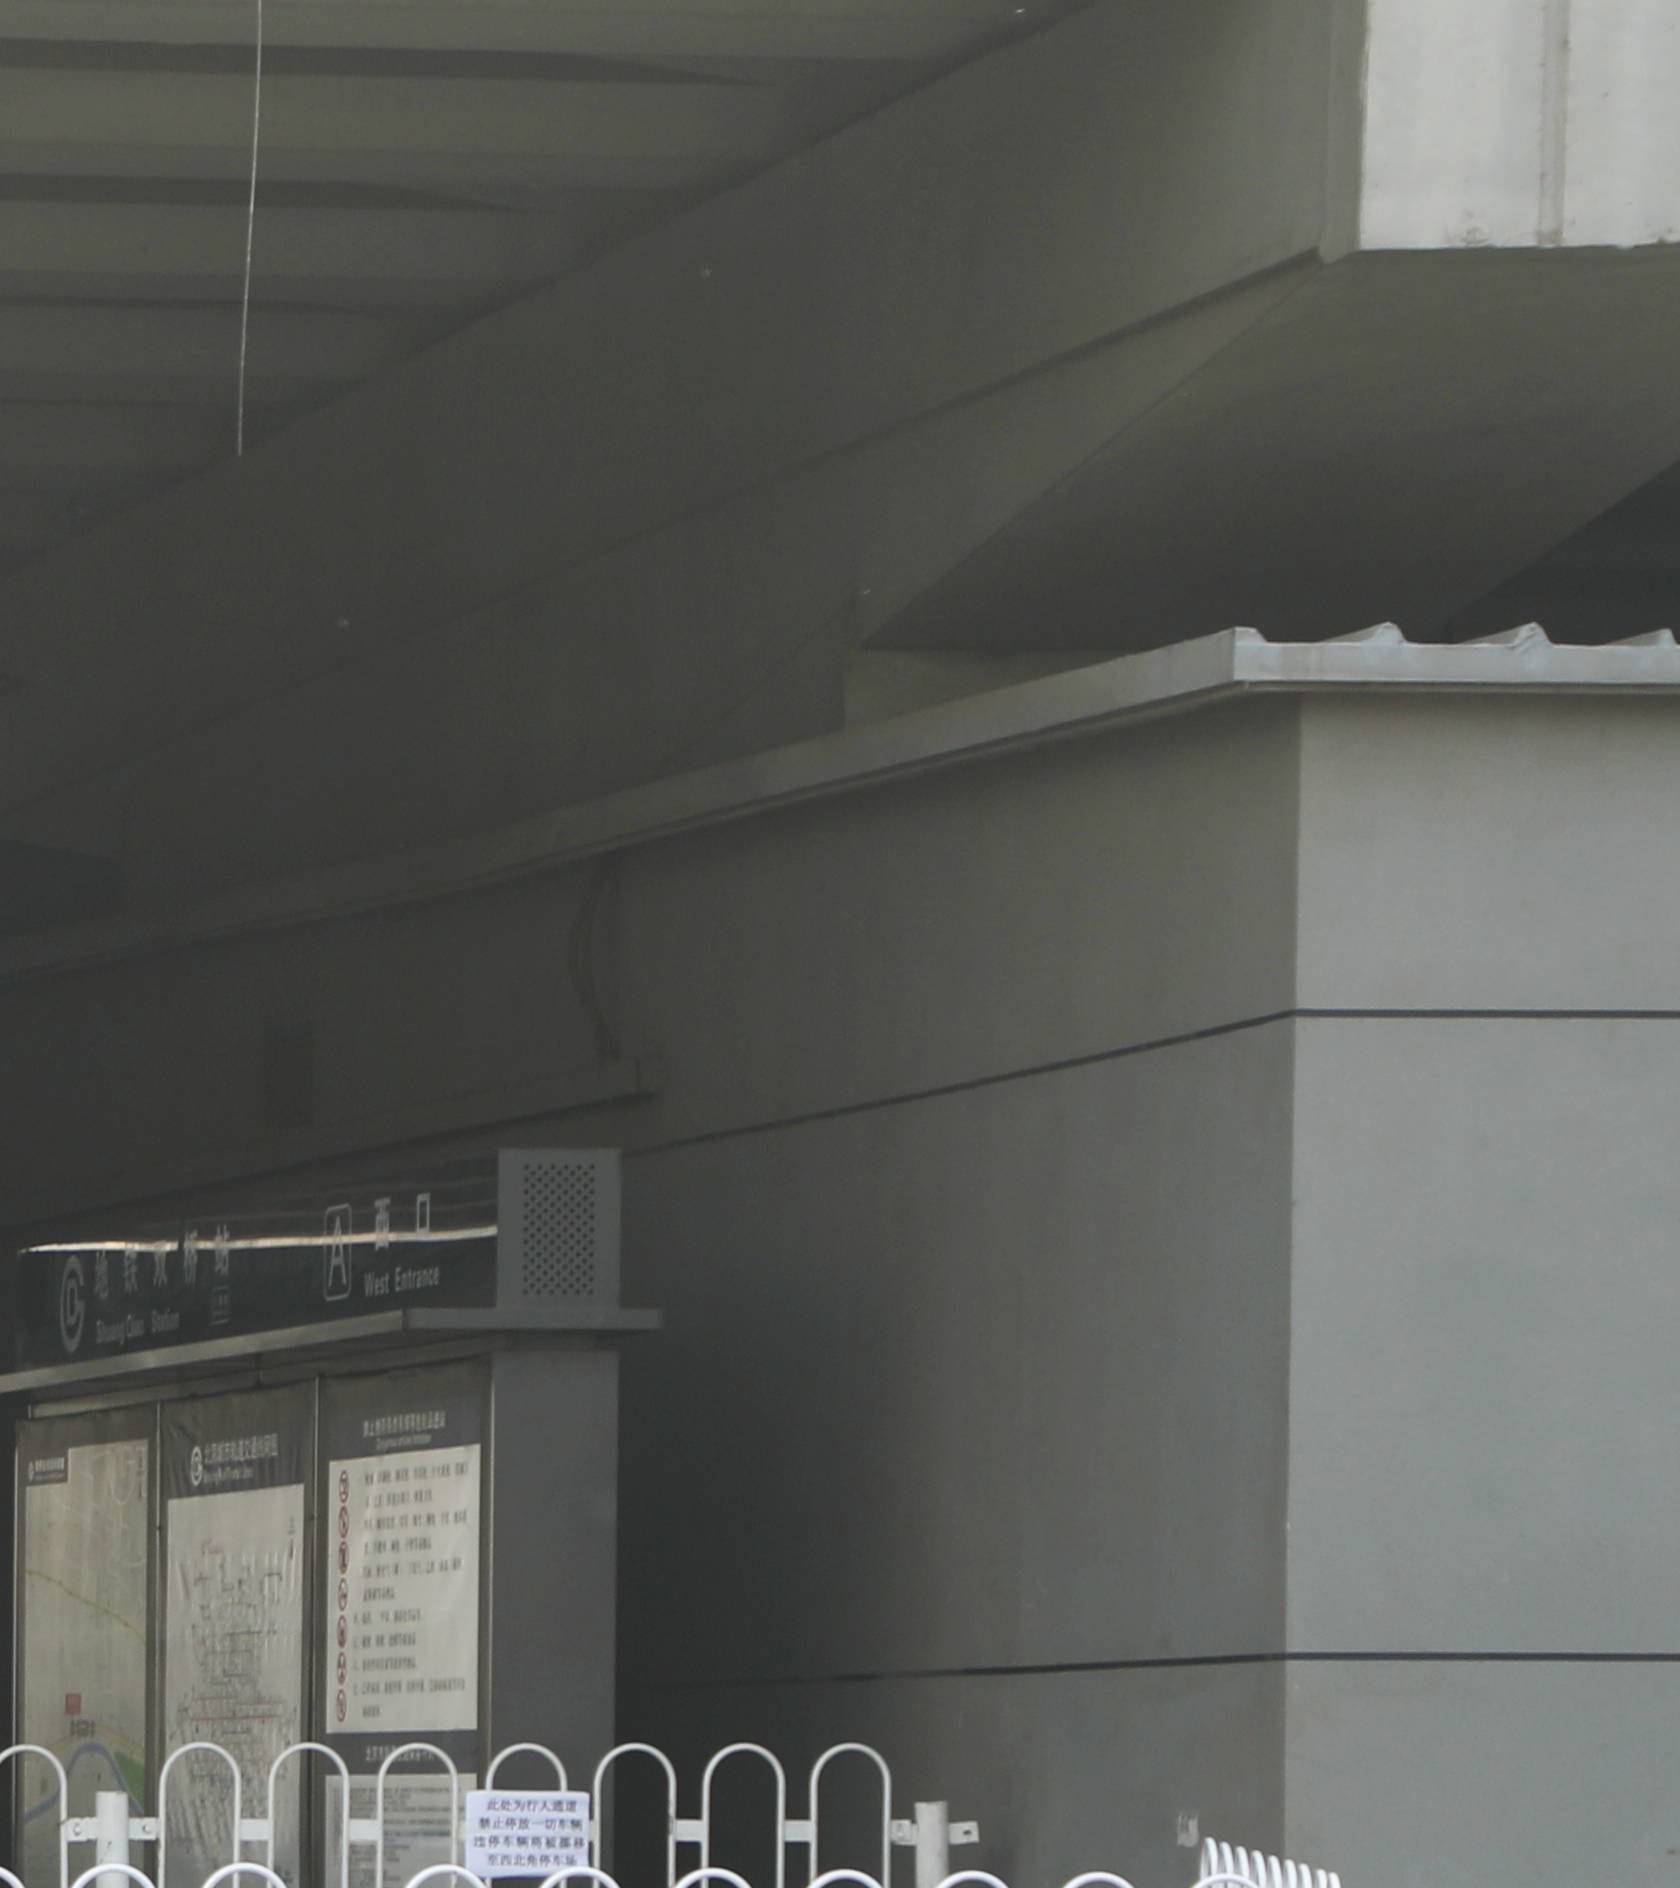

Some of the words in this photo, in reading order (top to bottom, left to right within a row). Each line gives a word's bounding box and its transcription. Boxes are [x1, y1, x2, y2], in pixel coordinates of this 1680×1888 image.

[373, 1192, 431, 1251] 西口
[328, 1215, 347, 1289] A
[364, 1271, 390, 1297] West
[395, 1265, 440, 1293] Entrance
[486, 1799, 577, 1813] 此处为行人通道
[478, 1817, 583, 1832] 禁止停放一切车辆
[488, 1851, 577, 1868] 至西北角停车场
